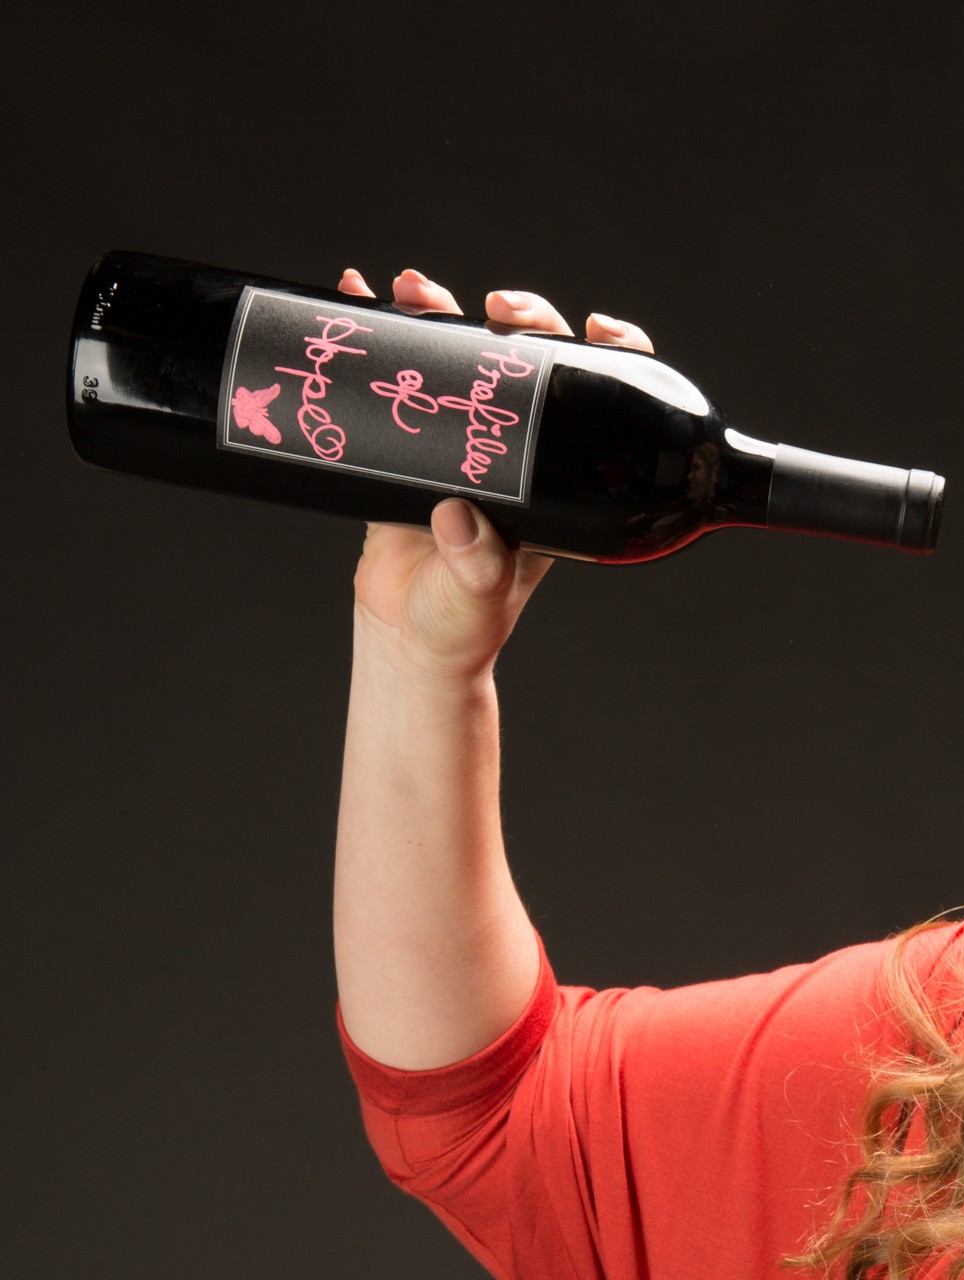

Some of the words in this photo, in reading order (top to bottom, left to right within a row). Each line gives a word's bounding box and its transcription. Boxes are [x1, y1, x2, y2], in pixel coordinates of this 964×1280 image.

[275, 314, 374, 461] Hope
[370, 369, 439, 435] of
[437, 347, 536, 484] Profiles
